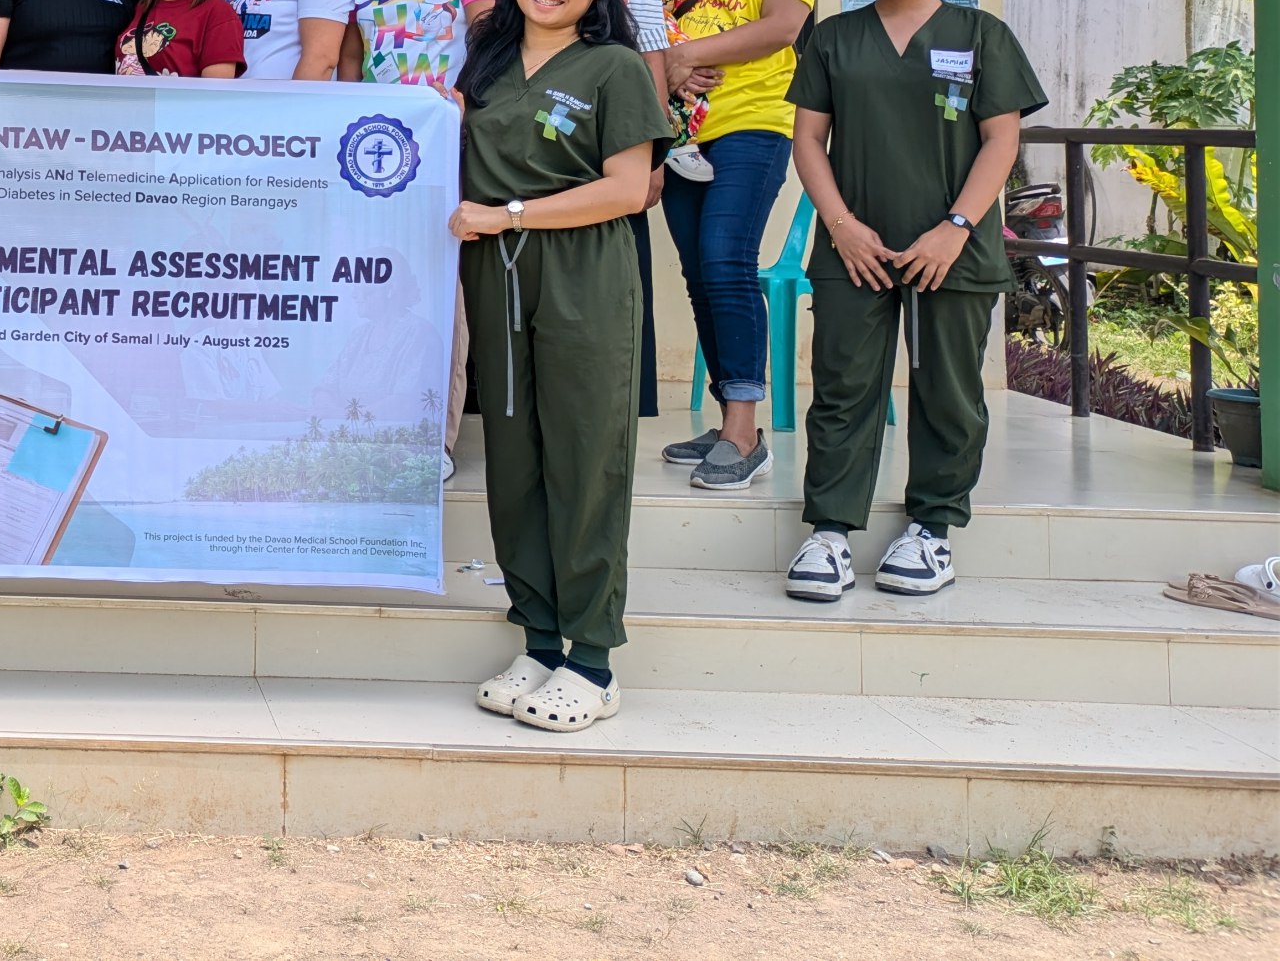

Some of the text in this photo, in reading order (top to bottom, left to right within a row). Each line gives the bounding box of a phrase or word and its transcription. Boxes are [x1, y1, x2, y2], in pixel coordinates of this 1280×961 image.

[363, 124, 390, 133] SCHOOL
[92, 129, 192, 154] DABAW
[198, 133, 321, 158] PROJECT
[348, 131, 363, 157] MEDICAL
[45, 168, 73, 181] ANd
[78, 170, 165, 184] Telemedicine
[169, 172, 241, 188] Application
[246, 174, 262, 186] for
[267, 176, 328, 189] Residents
[348, 159, 361, 180] DAVAO
[59, 189, 70, 201] in
[74, 190, 131, 203] Selected
[135, 192, 177, 204] Davao
[182, 193, 226, 208] Region
[230, 195, 297, 210] Barangays
[128, 250, 320, 282] ASSESSMENT
[332, 256, 392, 284] AND
[131, 290, 339, 323] RECRUITMENT
[10, 329, 59, 342] Garden
[64, 330, 90, 345] City
[94, 331, 108, 343] of
[111, 332, 153, 345] Samal
[163, 333, 190, 348] July
[202, 335, 250, 349] August
[253, 336, 290, 348] 2025
[144, 532, 427, 550] This project is funded by the Davao Medical School Foundation Inc.,
[209, 544, 427, 559] through their Center for Research and Development
